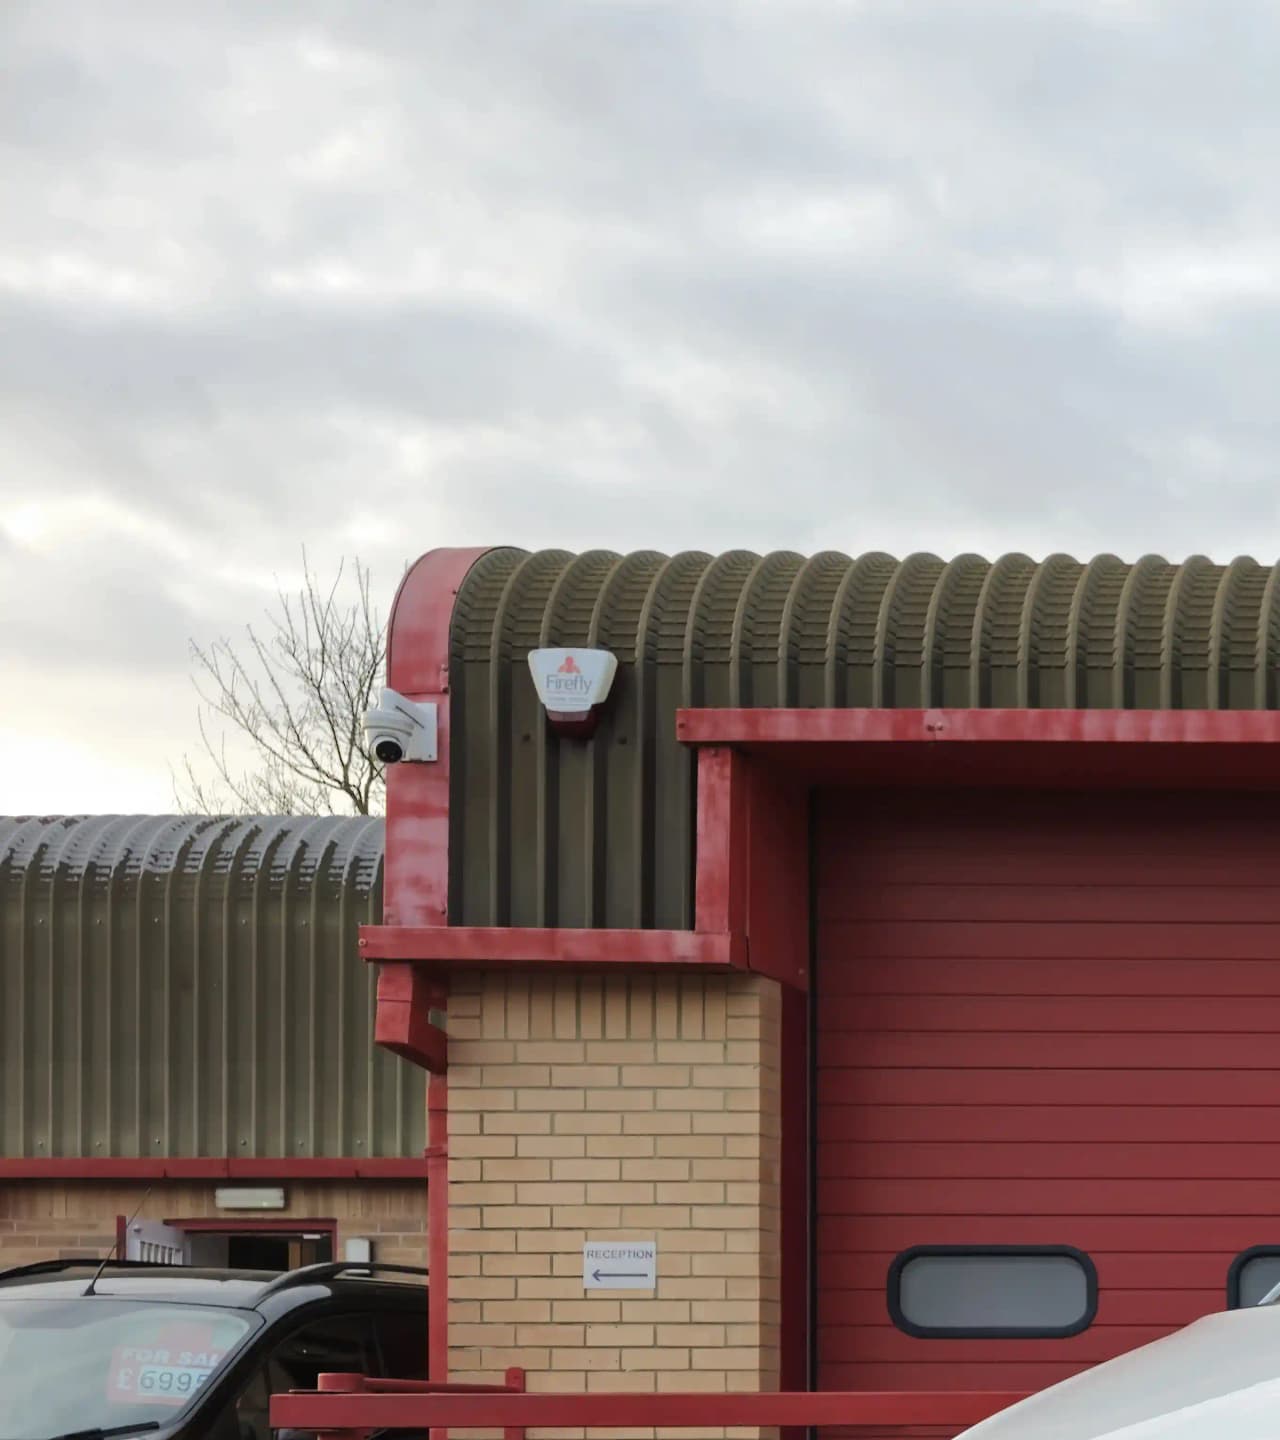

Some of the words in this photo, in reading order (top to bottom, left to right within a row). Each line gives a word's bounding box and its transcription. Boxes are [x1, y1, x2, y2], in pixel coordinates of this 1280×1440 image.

[546, 674, 592, 695] Firefly
[586, 1249, 654, 1260] RECEPTION
[121, 1346, 171, 1364] FOR
